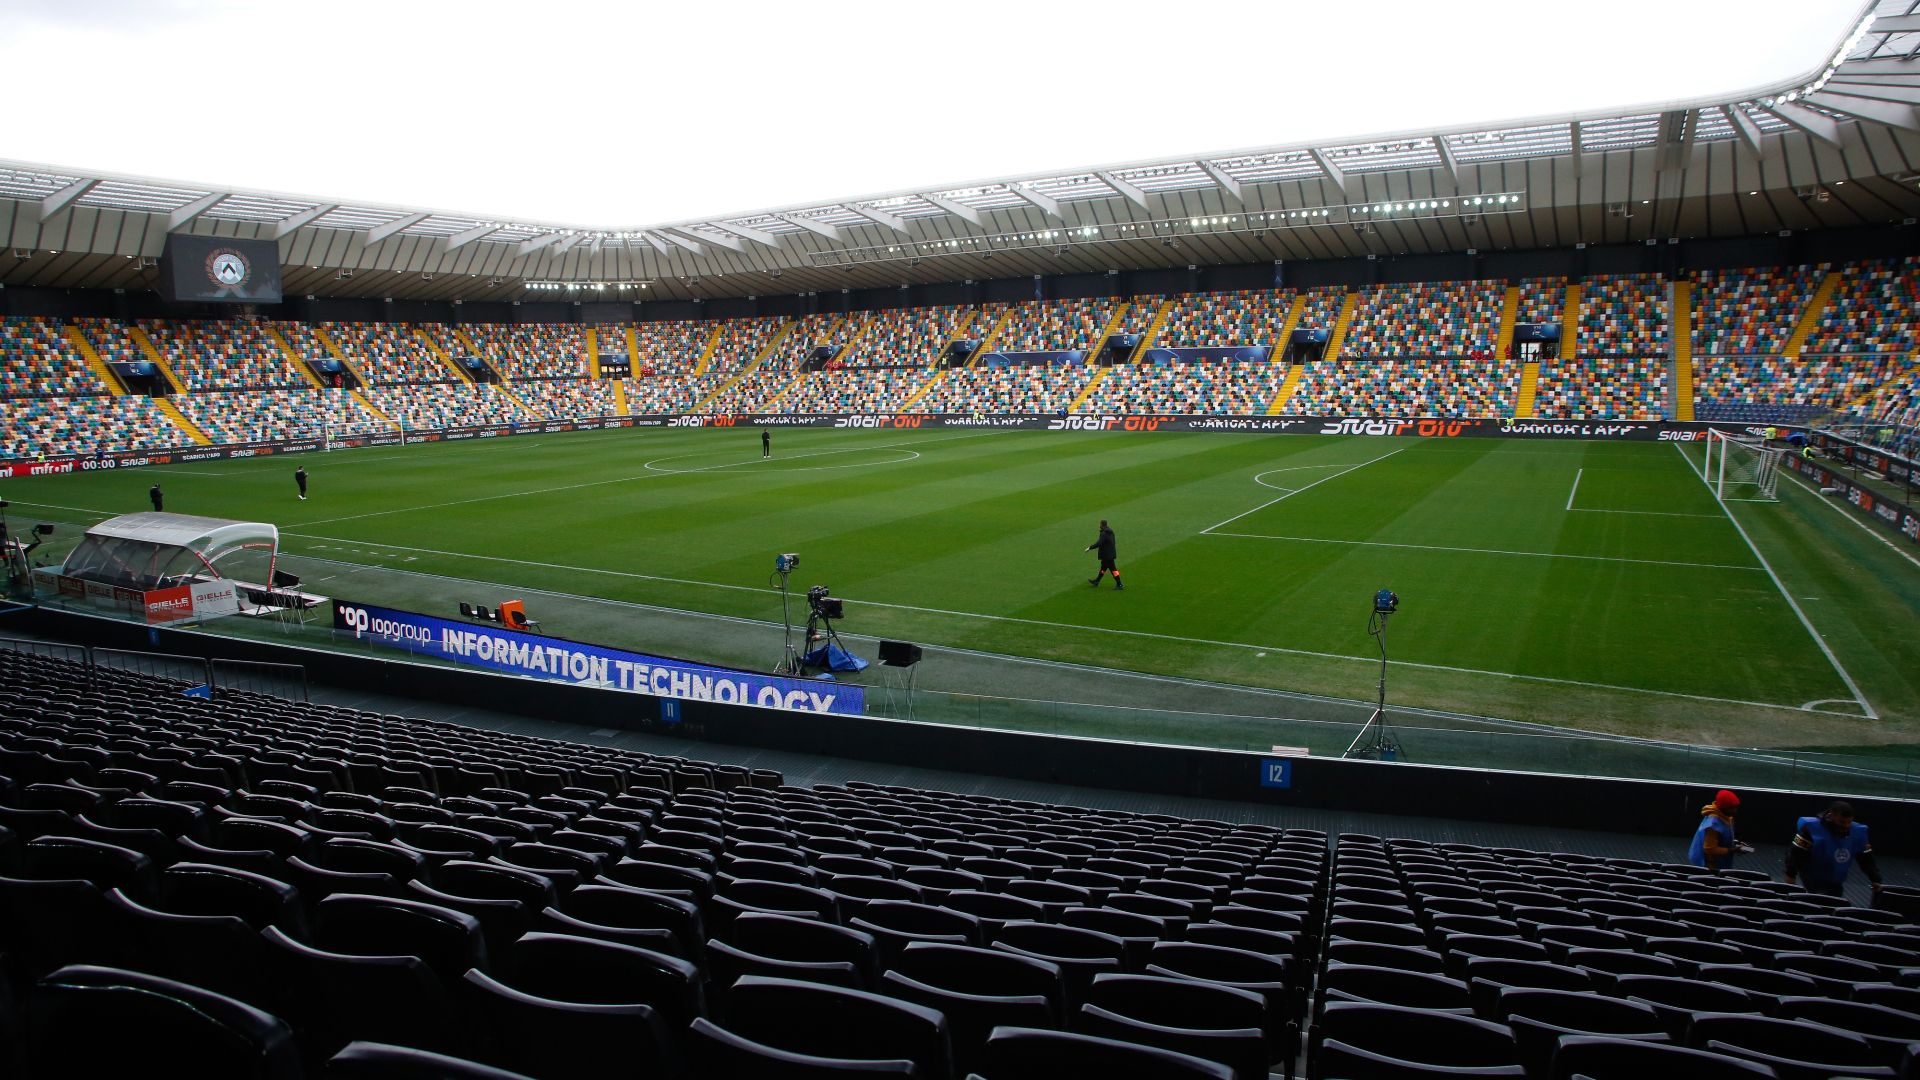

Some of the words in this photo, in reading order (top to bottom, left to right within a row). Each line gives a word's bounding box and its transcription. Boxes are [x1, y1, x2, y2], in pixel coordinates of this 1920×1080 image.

[82, 460, 115, 470] 00:00
[442, 627, 608, 682] INFORMATION
[615, 660, 836, 712] TECHNOLOGY
[666, 703, 674, 718] 11
[1269, 765, 1282, 782] 12
